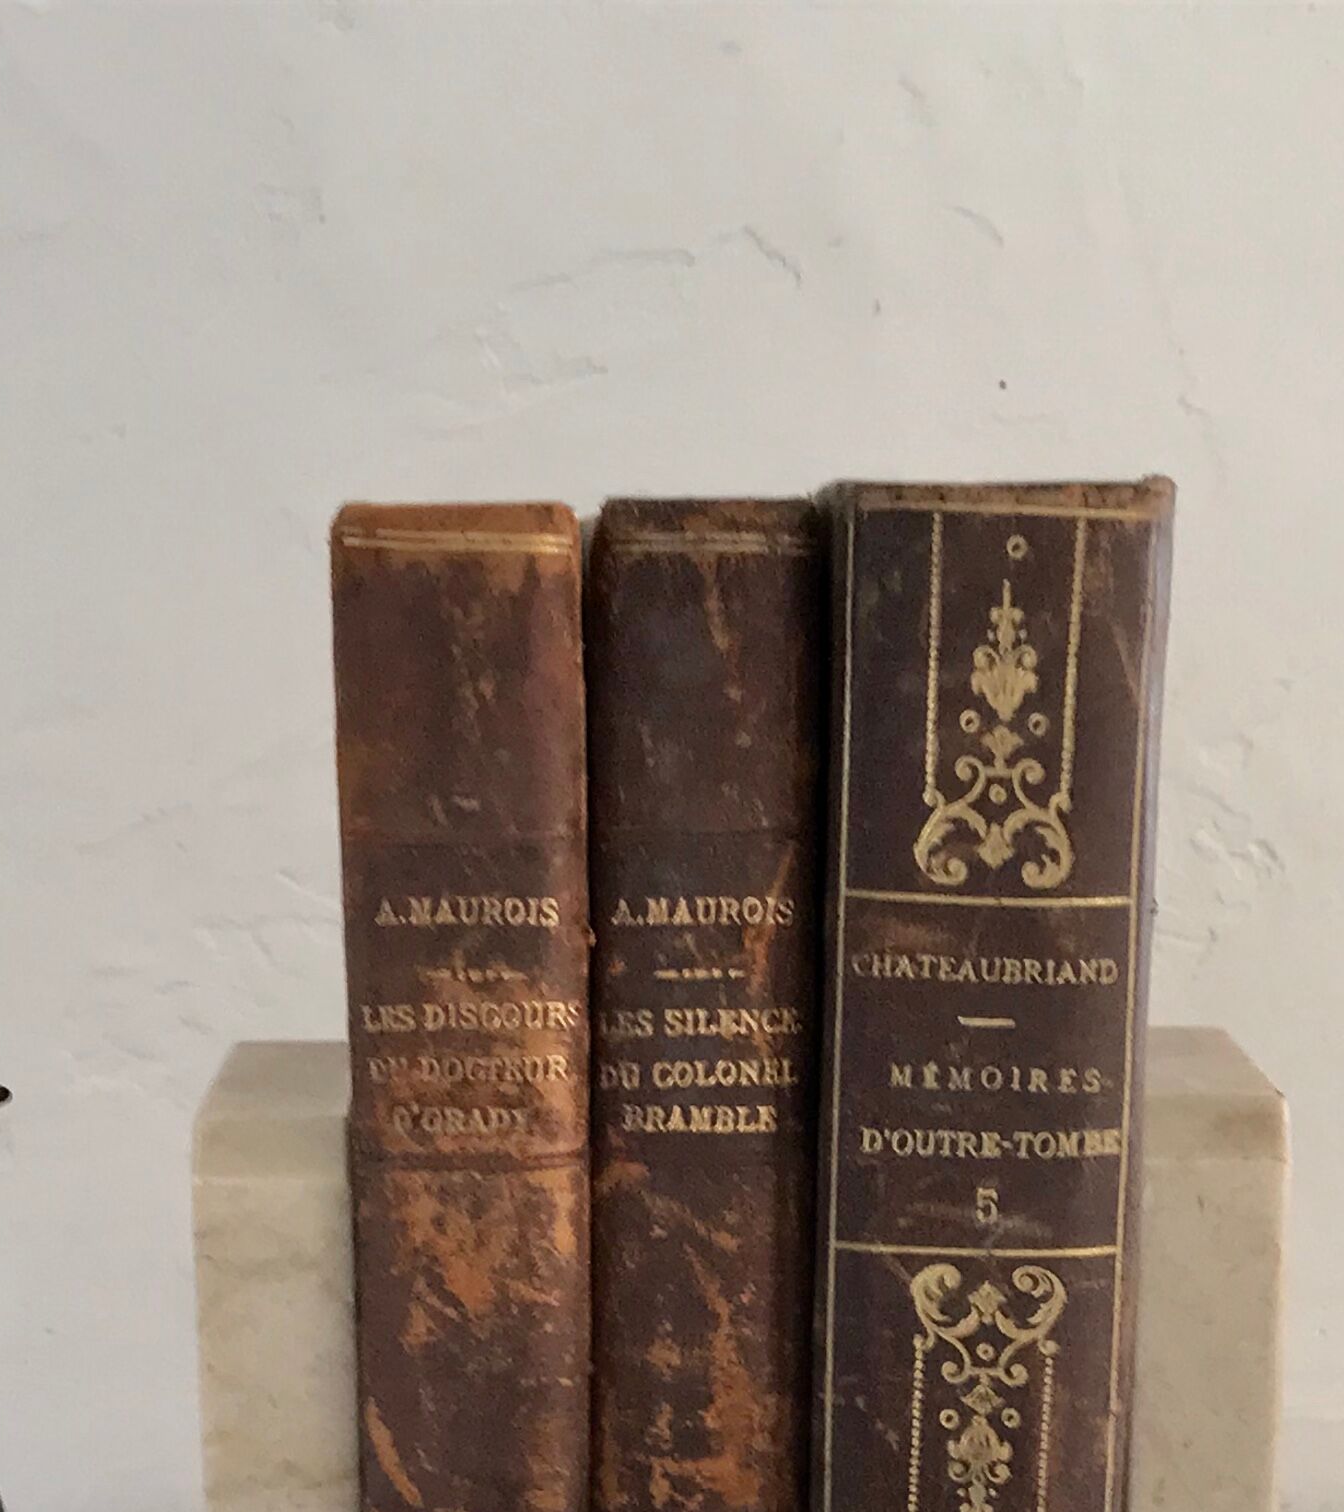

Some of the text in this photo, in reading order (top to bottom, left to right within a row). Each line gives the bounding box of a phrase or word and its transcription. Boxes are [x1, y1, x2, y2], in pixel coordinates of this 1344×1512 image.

[611, 896, 795, 926] A.MAUROIS
[852, 953, 1119, 985] CHATEAUBRIAND
[600, 1060, 641, 1090] DU
[889, 1061, 1103, 1094] MÉMOIRES
[622, 1104, 777, 1133] BRAMBLE
[860, 1126, 1122, 1159] D'OUTRE-TOMBE
[974, 1187, 1001, 1224] 5
